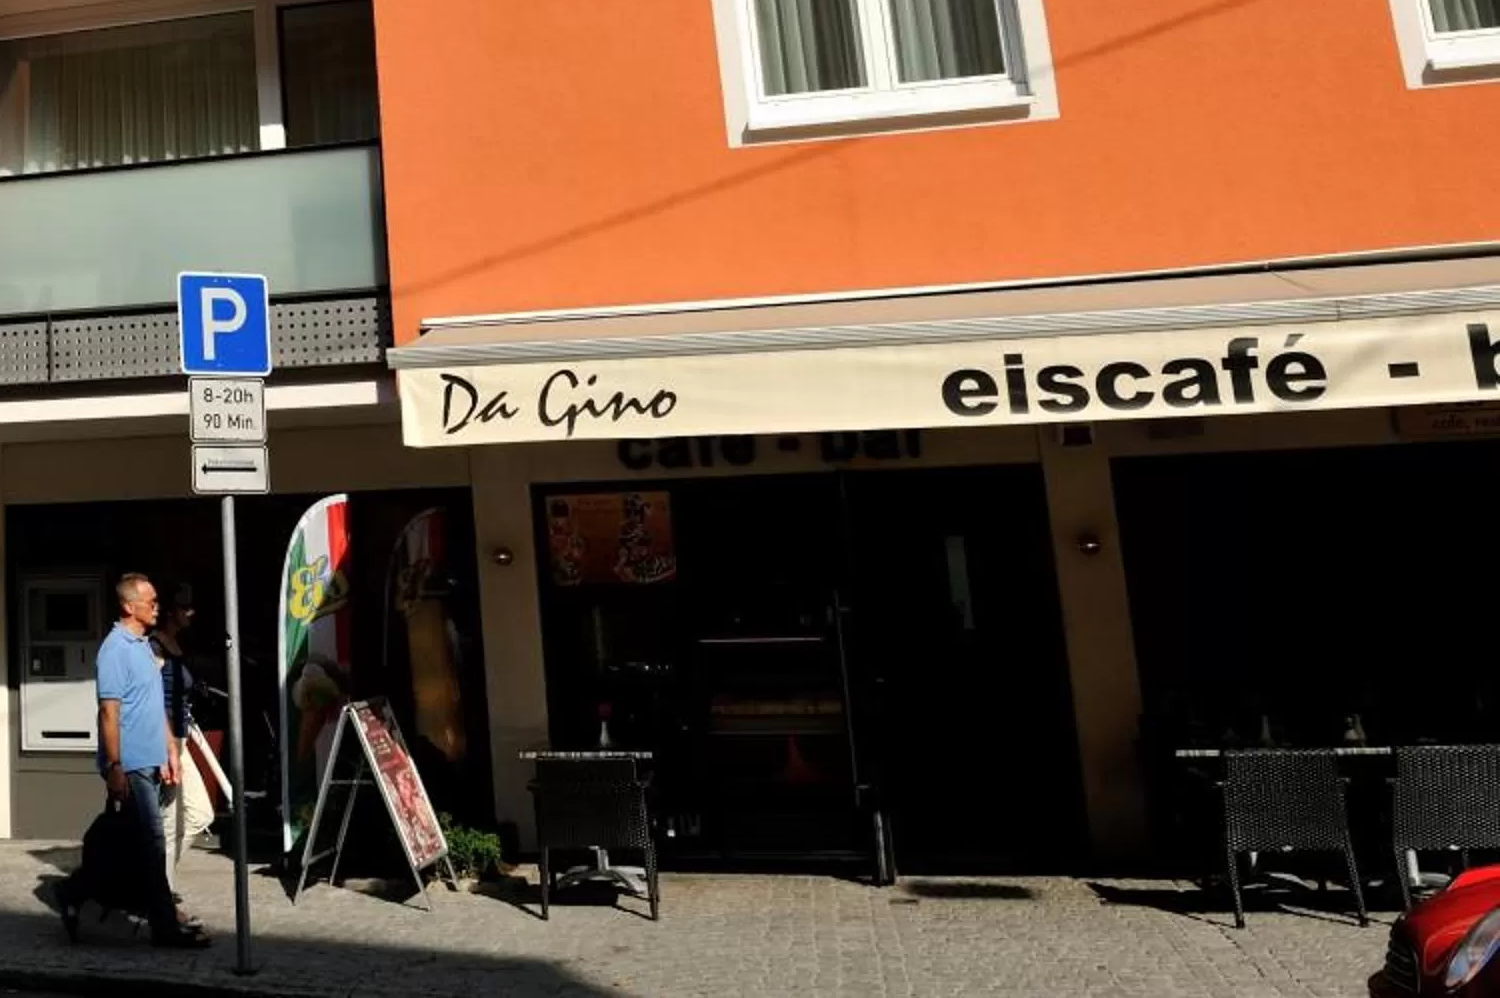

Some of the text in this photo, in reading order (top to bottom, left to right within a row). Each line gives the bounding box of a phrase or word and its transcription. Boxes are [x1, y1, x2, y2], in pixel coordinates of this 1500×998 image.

[201, 287, 247, 361] P
[203, 387, 254, 404] 8-20h
[440, 369, 677, 436] Da Gino
[941, 333, 1327, 417] eiscafé
[203, 413, 221, 429] 90
